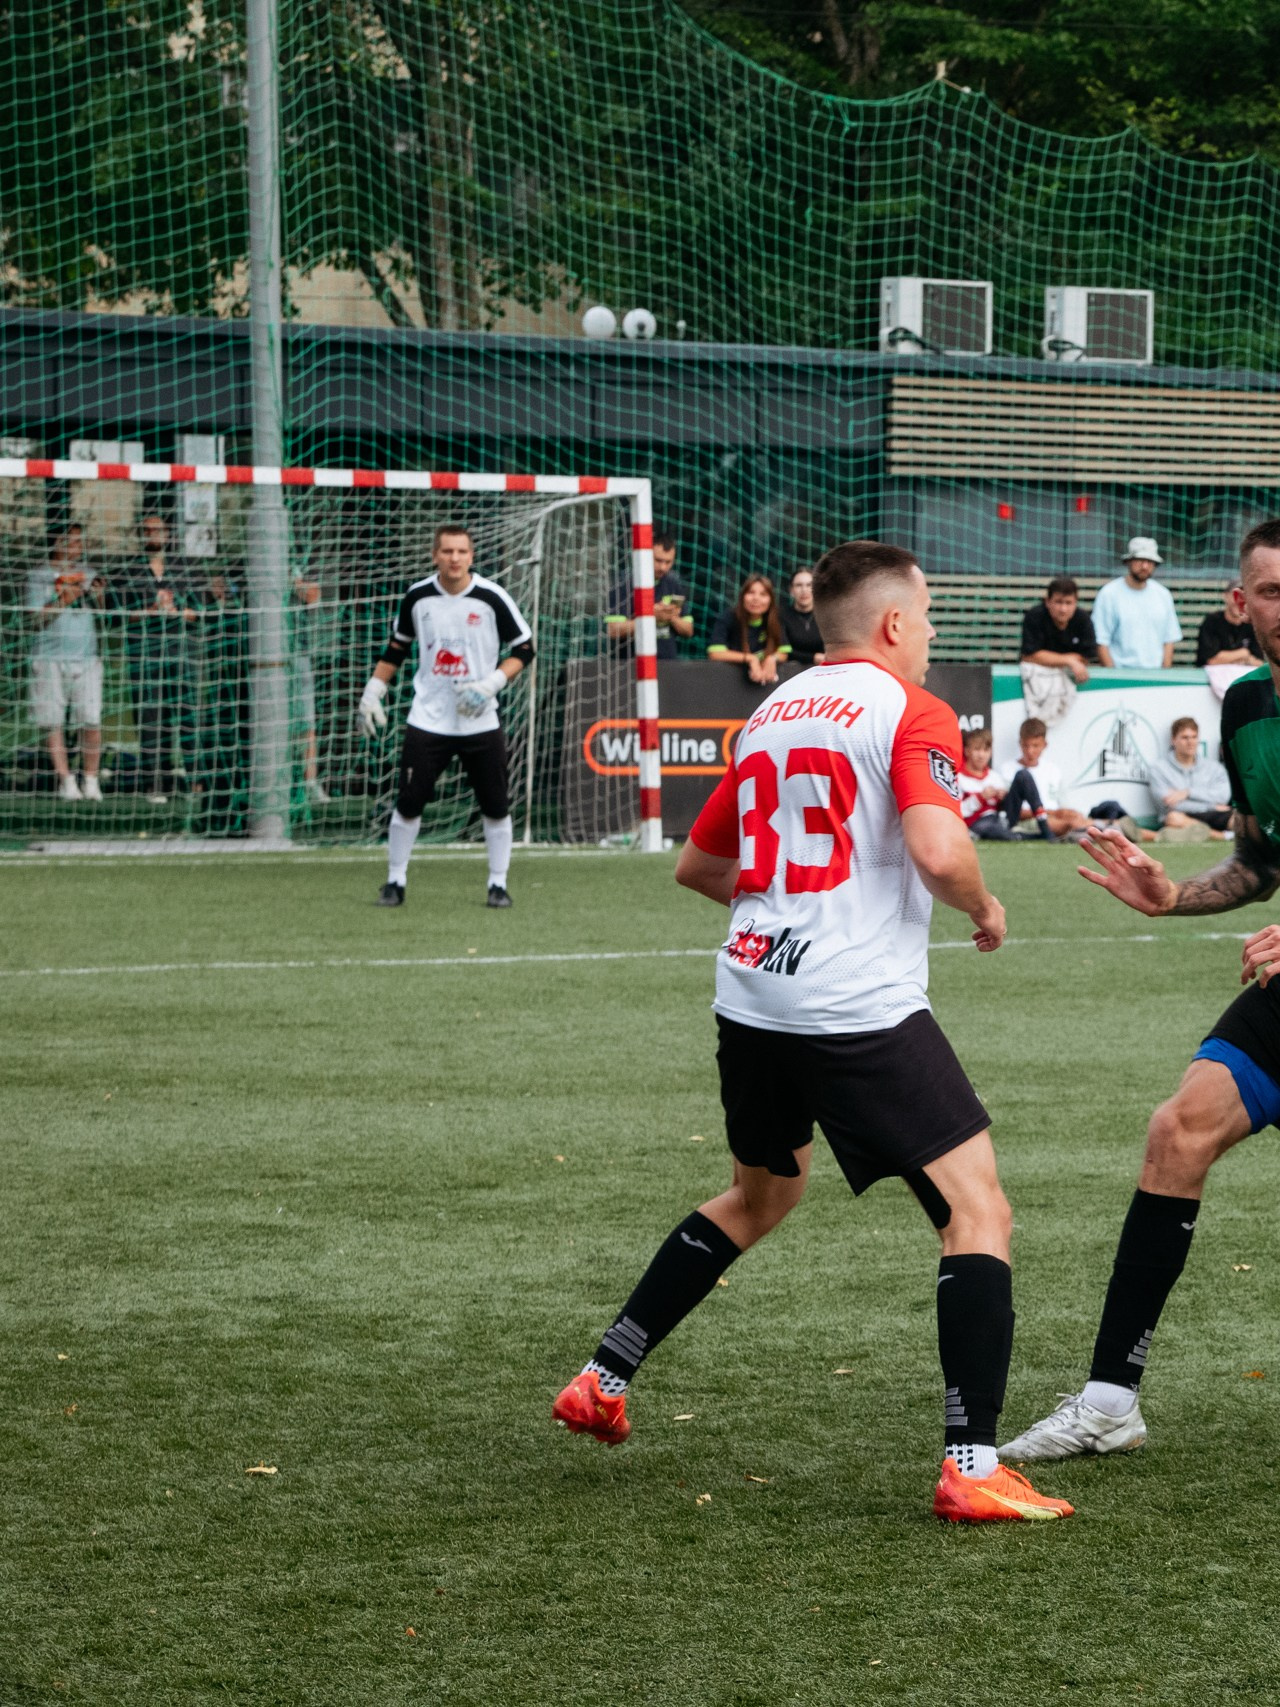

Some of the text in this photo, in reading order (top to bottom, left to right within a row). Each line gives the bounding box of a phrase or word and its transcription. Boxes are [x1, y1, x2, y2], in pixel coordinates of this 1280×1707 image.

[748, 695, 864, 736] БЛОХИН
[601, 732, 717, 763] Wiline
[732, 747, 857, 899] 33
